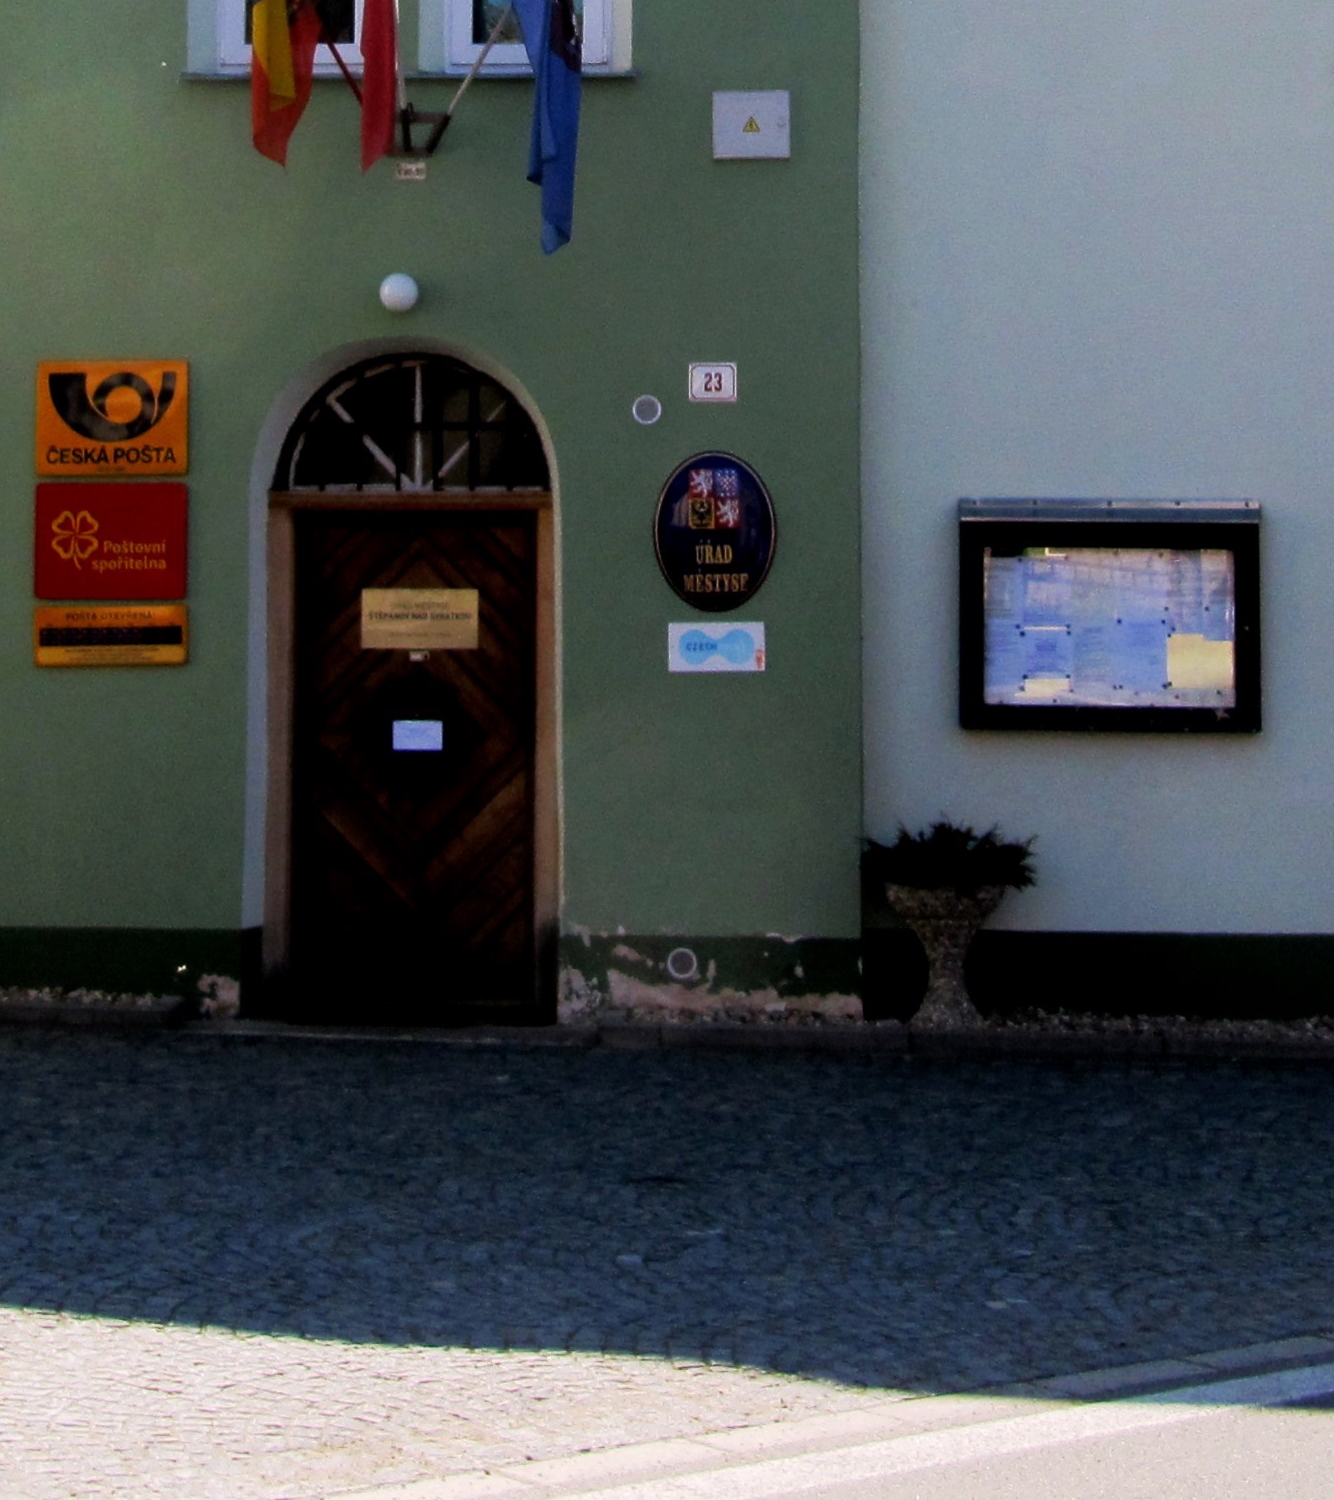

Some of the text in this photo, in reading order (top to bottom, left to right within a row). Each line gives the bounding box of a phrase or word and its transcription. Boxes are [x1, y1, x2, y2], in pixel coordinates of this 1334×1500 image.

[704, 372, 723, 392] 23
[46, 445, 176, 467] ČESKÁ POŠTA
[103, 539, 166, 553] Poštovní
[695, 538, 733, 565] ÚŘAD
[92, 555, 167, 574] spořitelna
[683, 567, 749, 593] MĚSTYSE
[686, 642, 718, 652] CZECH
